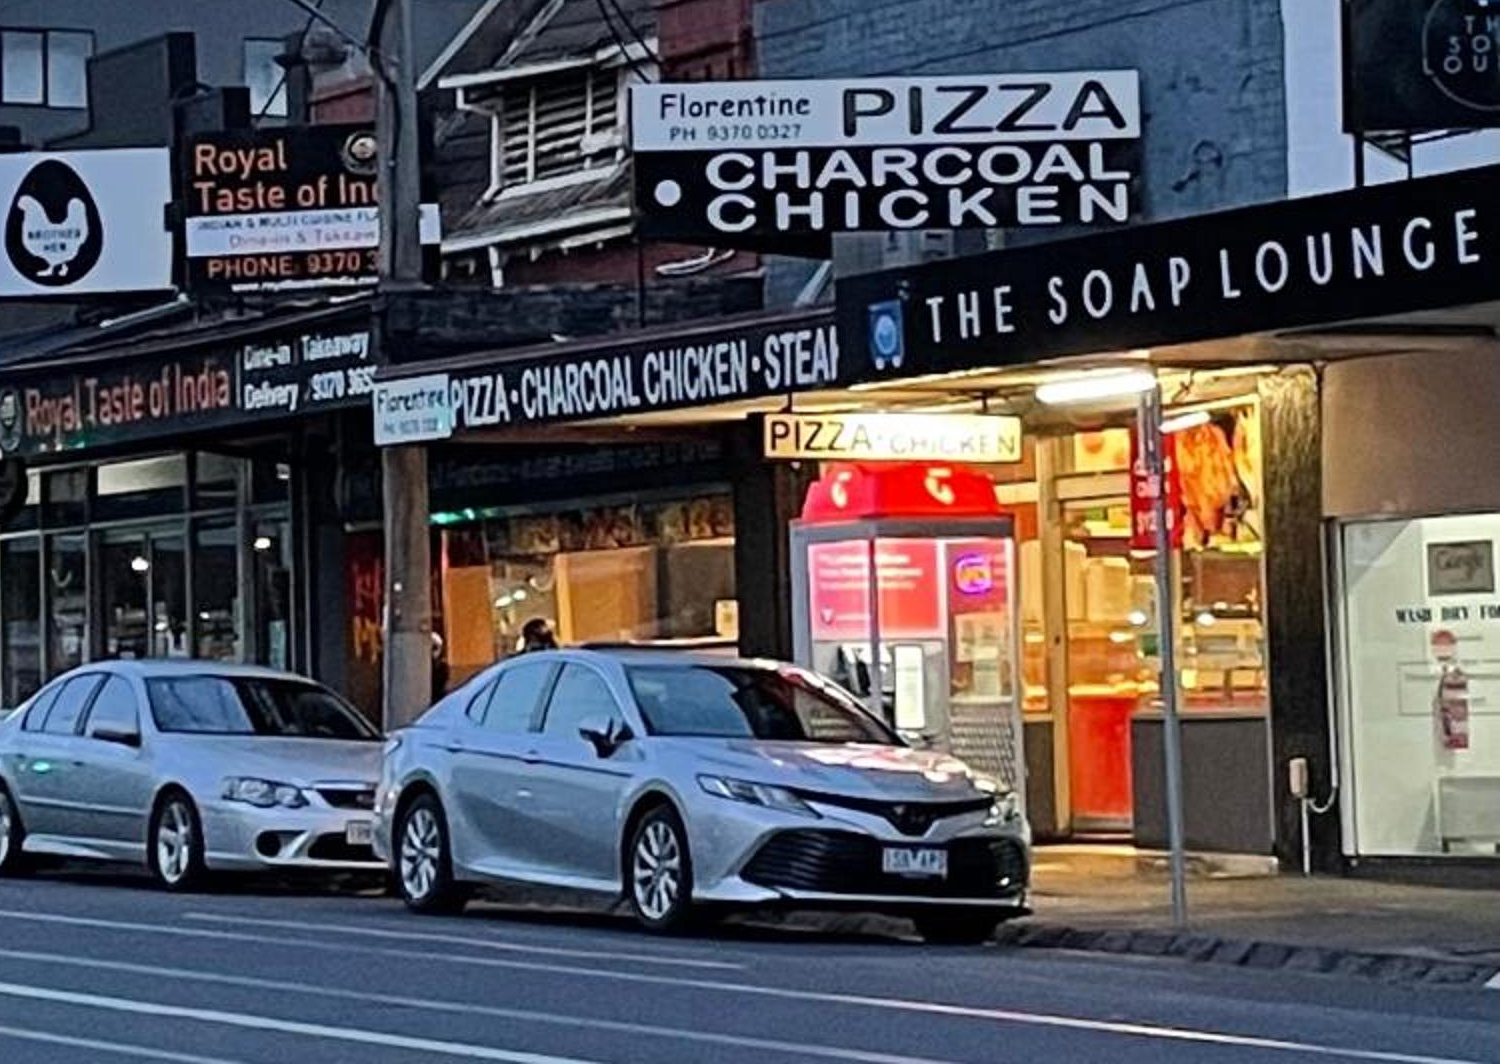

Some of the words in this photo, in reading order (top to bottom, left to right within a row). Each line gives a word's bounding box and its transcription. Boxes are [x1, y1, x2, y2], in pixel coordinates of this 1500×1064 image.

[660, 92, 810, 120] Florentine
[843, 80, 1127, 137] PIZZA
[670, 126, 697, 141] PH
[707, 125, 754, 140] 9370
[757, 124, 802, 139] 0327
[194, 139, 288, 179] Royal
[705, 142, 1131, 191] CHARCOAL
[194, 179, 286, 213] Taste
[297, 175, 328, 208] of
[706, 183, 1128, 232] CHICKEN
[207, 255, 293, 279] PHONE
[307, 252, 360, 272] 9370
[926, 285, 1014, 343] THE
[1047, 256, 1191, 326] SOAP
[1220, 208, 1481, 299] LOUNGE
[301, 332, 370, 361] Takeaway
[25, 376, 83, 434] Royal
[85, 377, 143, 426] Taste
[149, 364, 172, 418] of
[174, 360, 231, 412] India
[451, 373, 510, 427] PIZZA
[521, 358, 641, 419] CHARCOAL
[642, 339, 747, 403] CHICKEN
[770, 420, 873, 452] PIZZA
[889, 434, 1016, 456] CHICKEN
